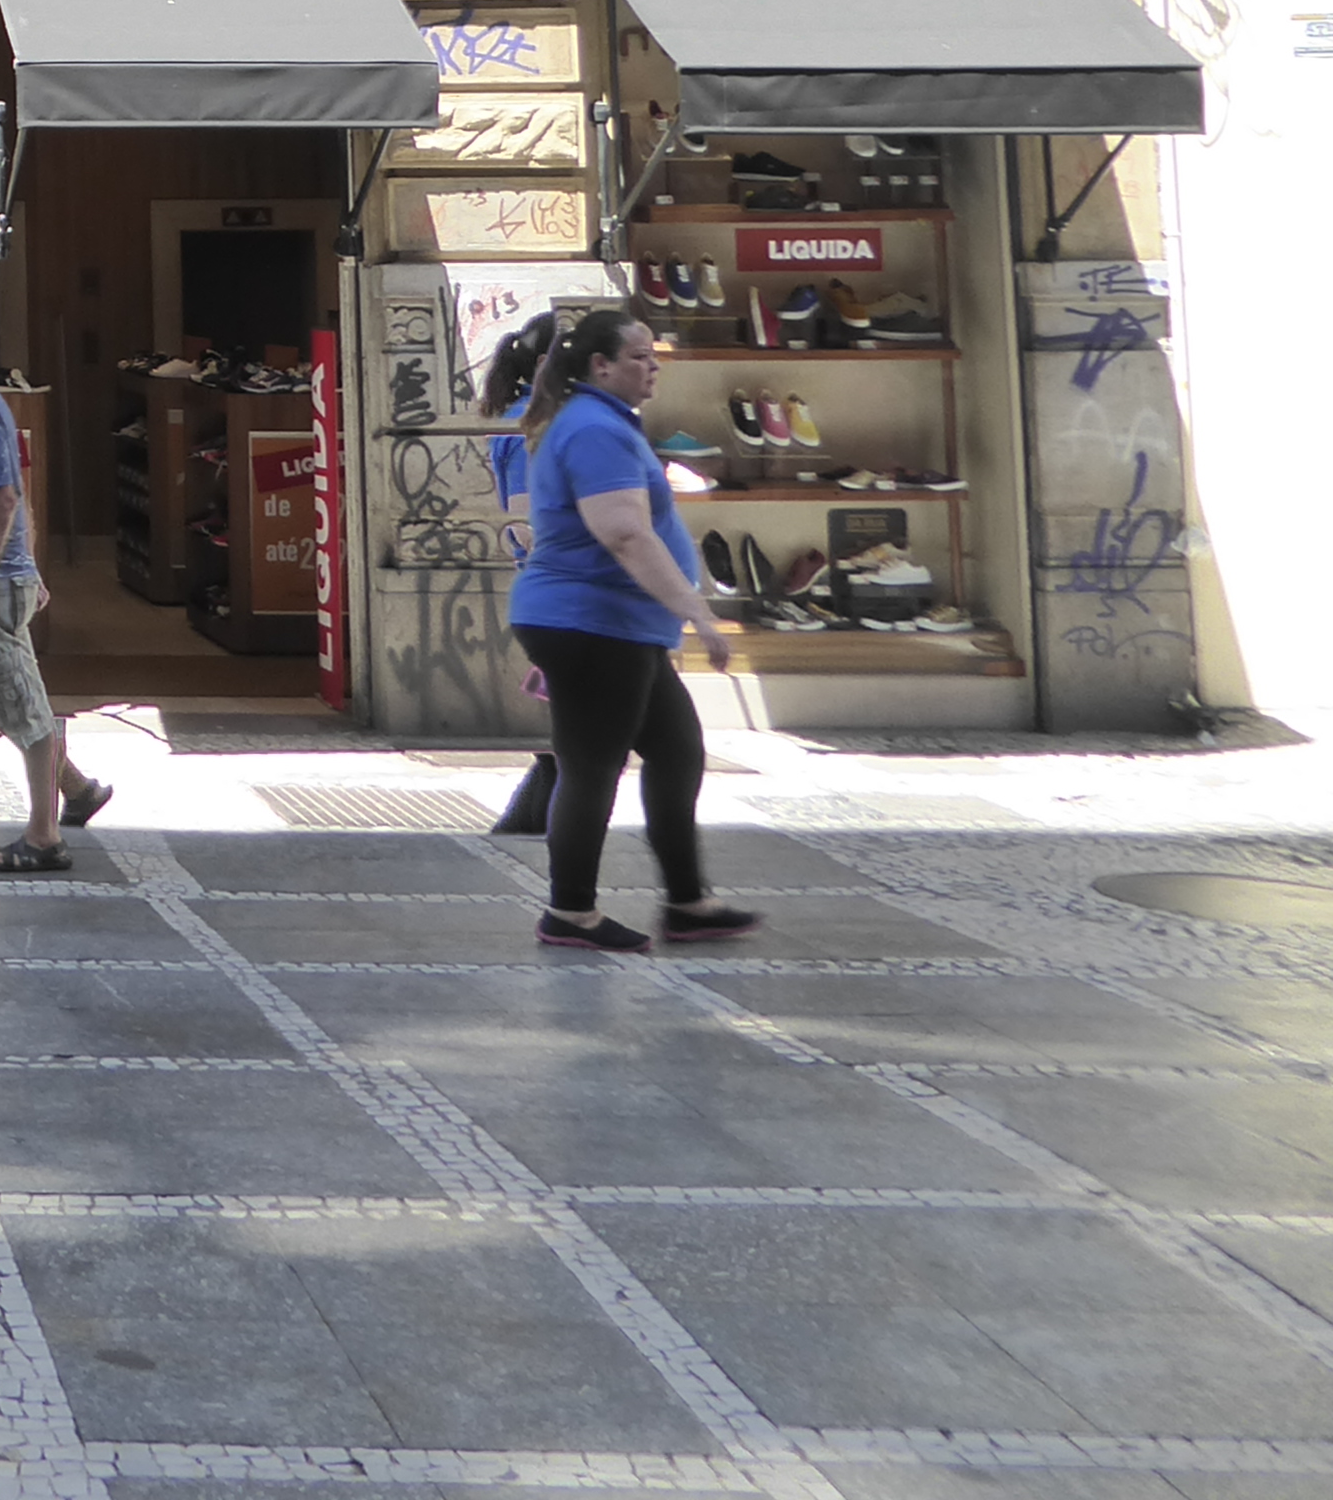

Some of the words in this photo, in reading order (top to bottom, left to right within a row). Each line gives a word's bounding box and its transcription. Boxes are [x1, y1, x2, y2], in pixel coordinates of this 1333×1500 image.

[768, 239, 875, 260] LIQUIDA
[264, 494, 291, 517] de
[312, 363, 333, 672] LIQUIDA
[265, 537, 298, 562] até
